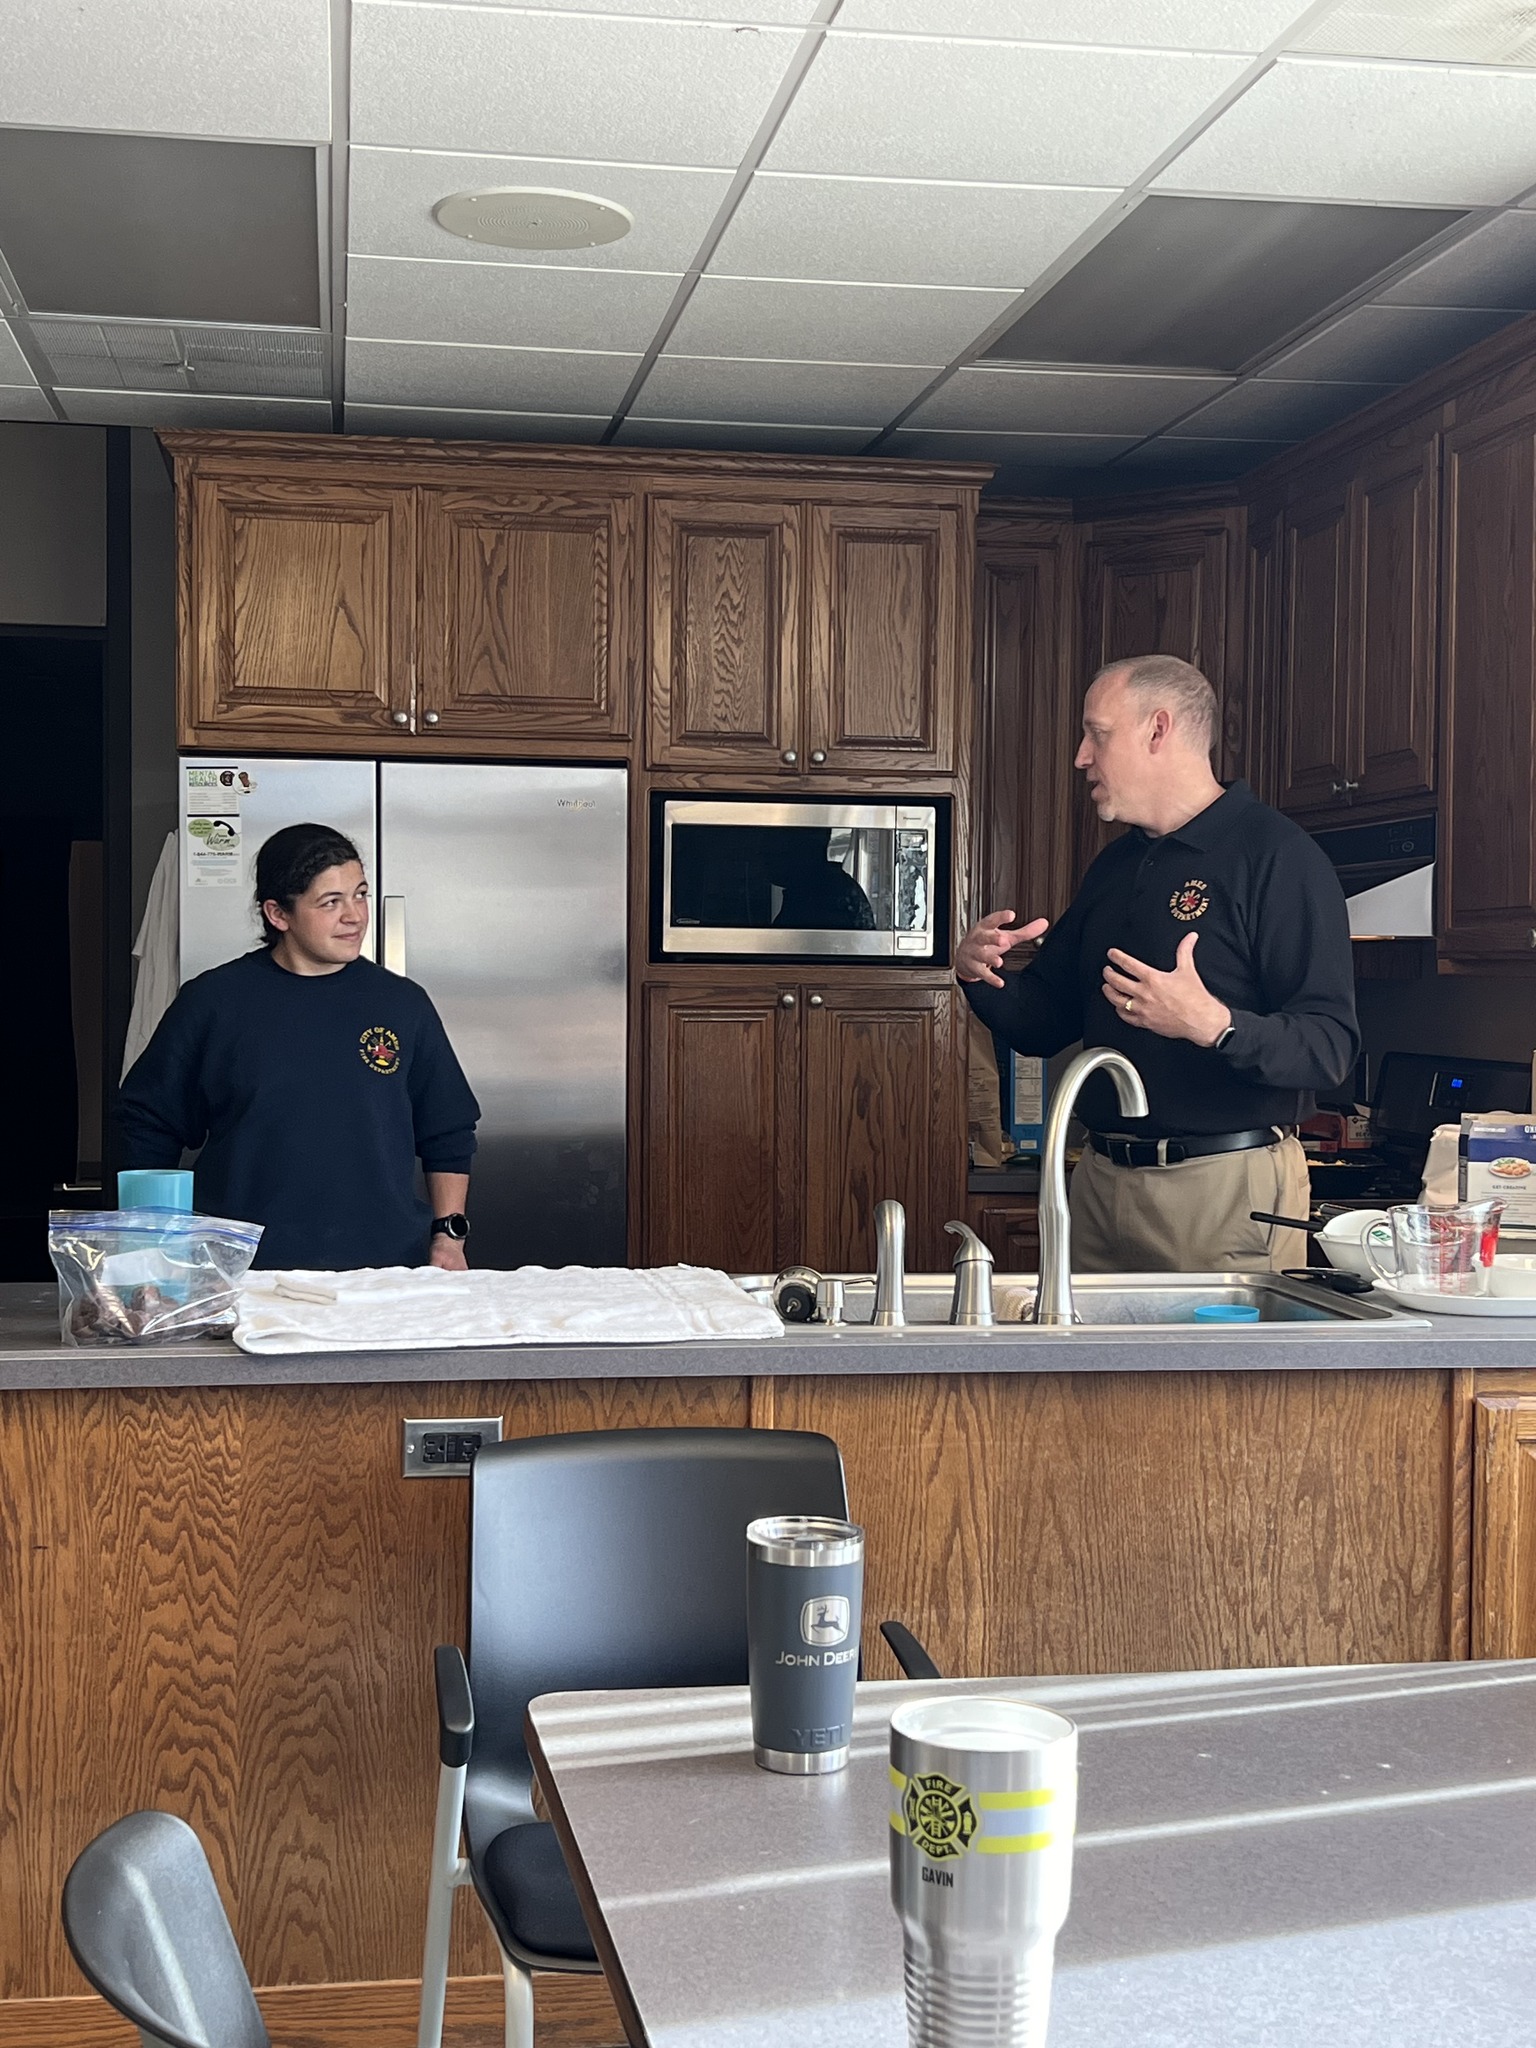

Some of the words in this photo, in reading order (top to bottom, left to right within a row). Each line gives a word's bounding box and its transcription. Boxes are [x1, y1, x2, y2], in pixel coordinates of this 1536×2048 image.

[775, 1651, 820, 1667] JOHN
[823, 1647, 857, 1666] DEER
[791, 1723, 846, 1748] YETI
[925, 1779, 953, 1794] FIRE
[921, 1839, 953, 1855] DEPT.
[921, 1866, 954, 1888] GAVIN
